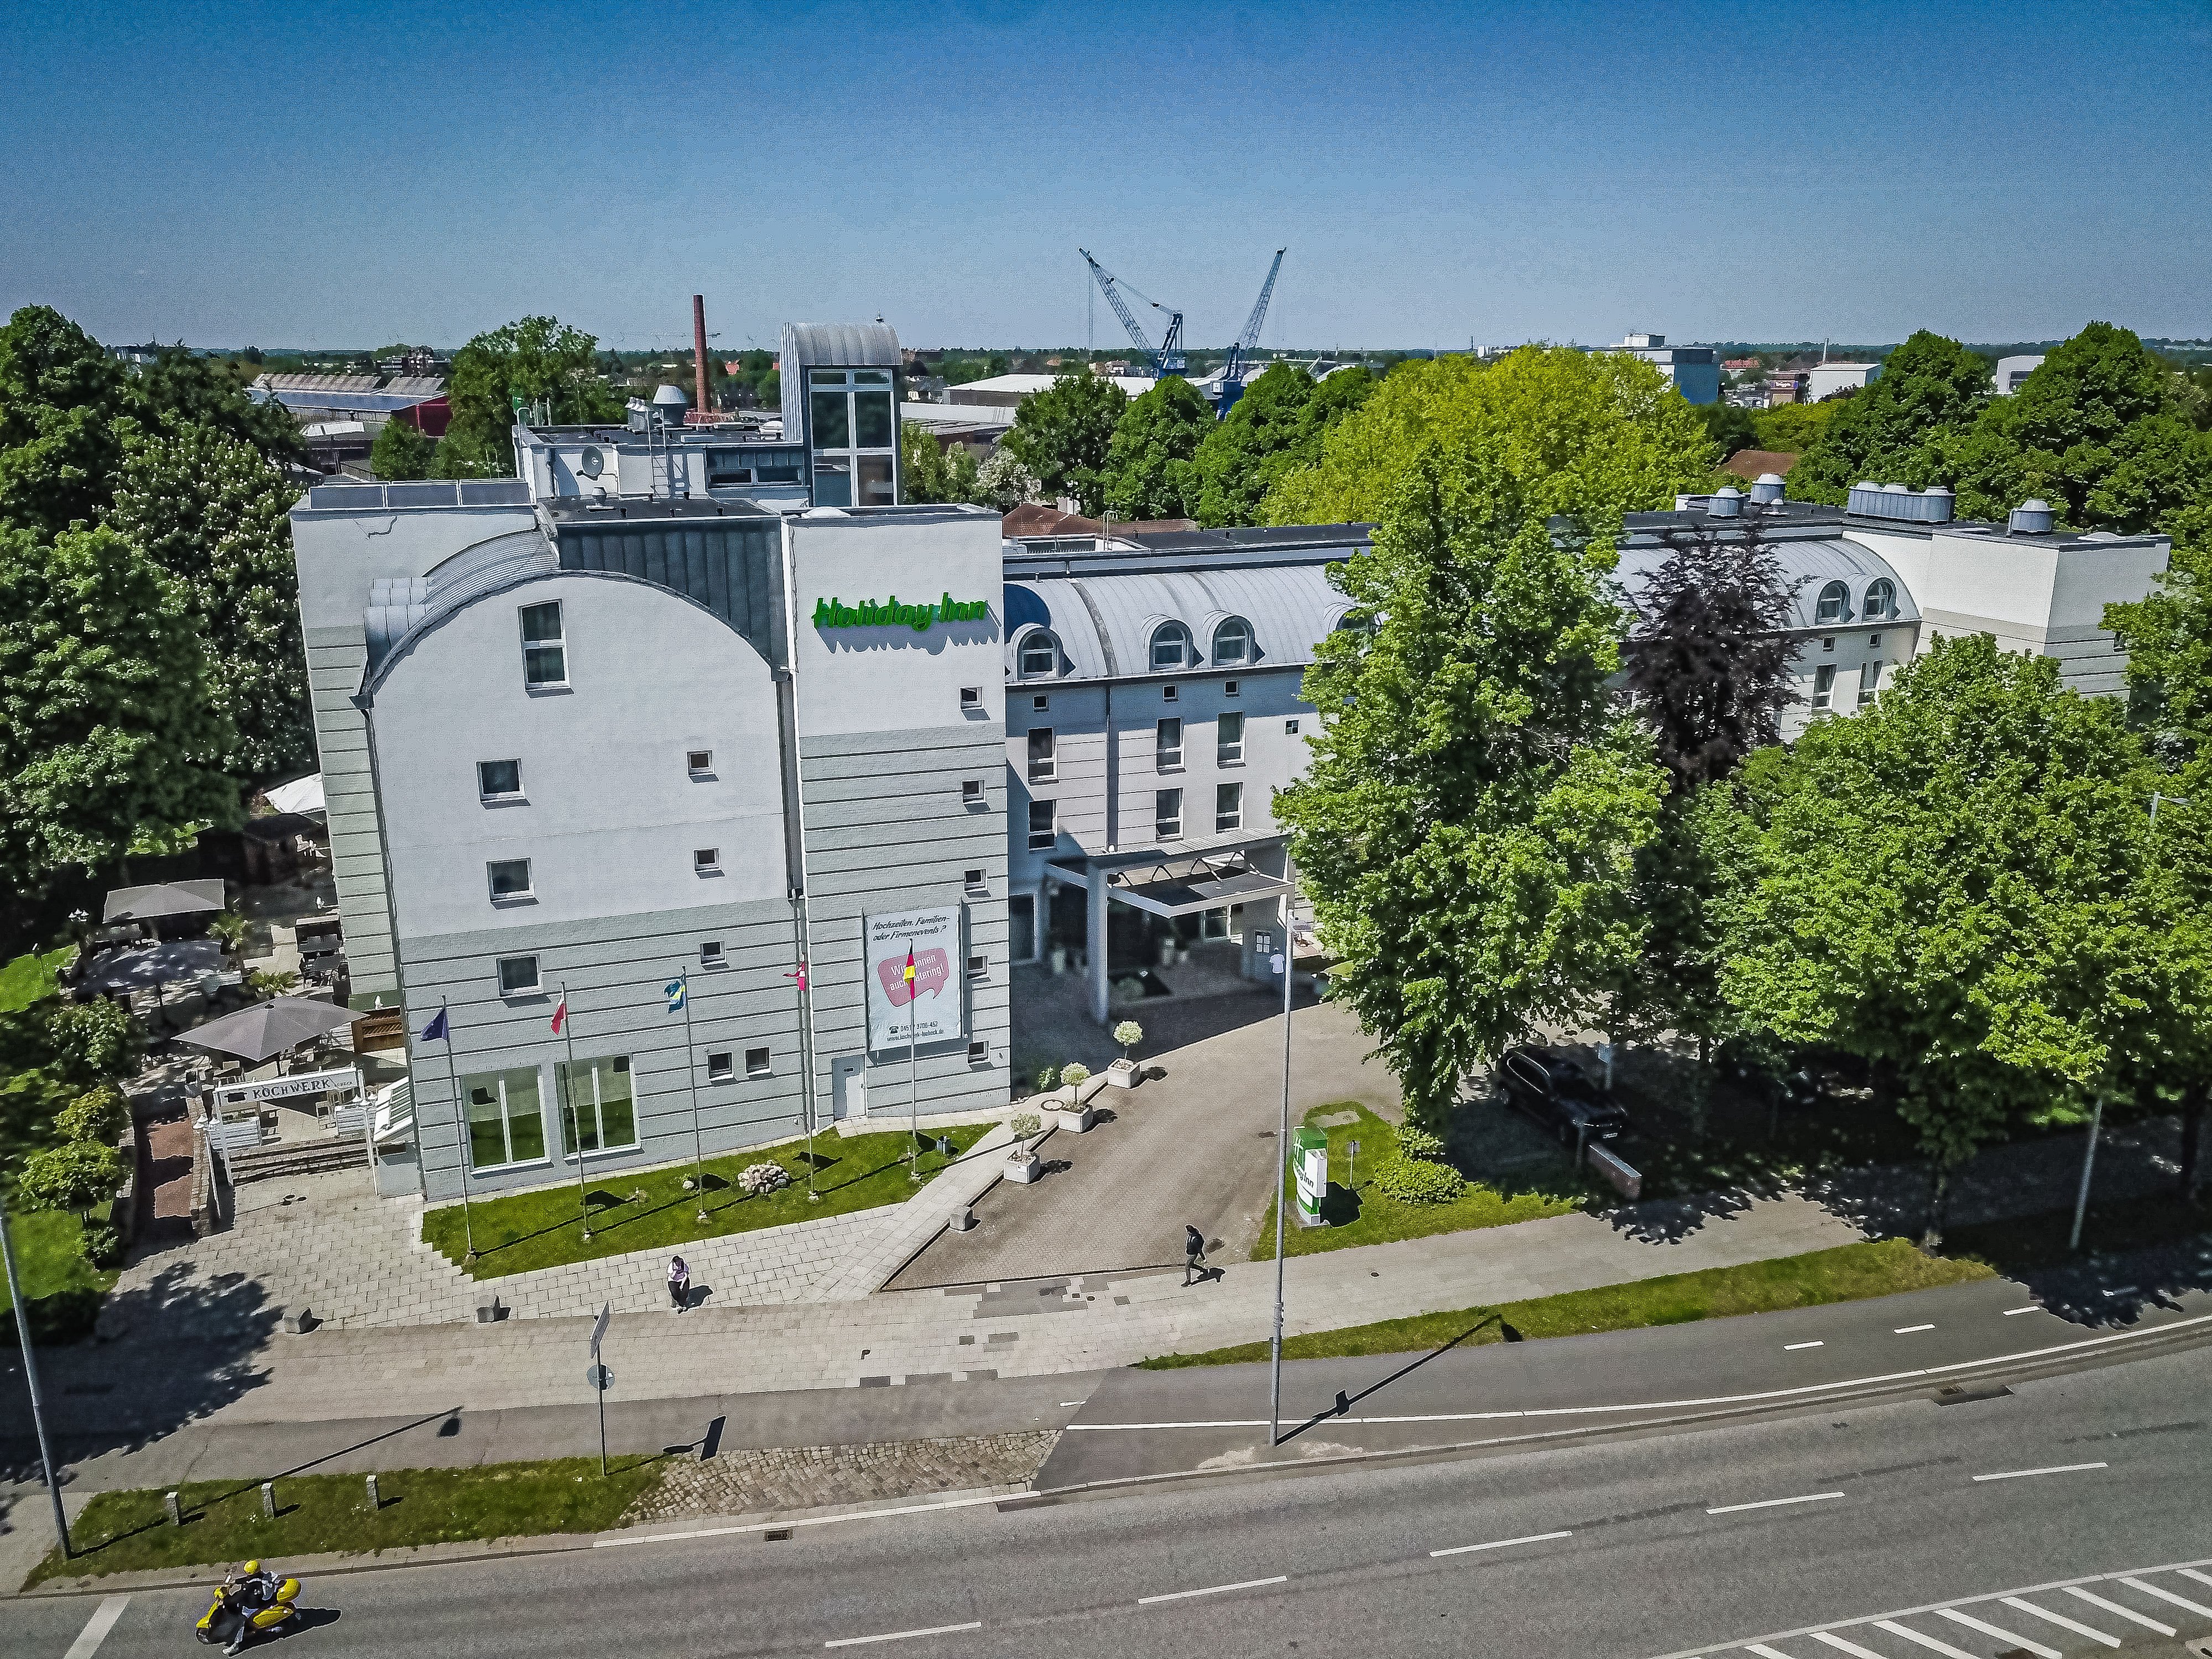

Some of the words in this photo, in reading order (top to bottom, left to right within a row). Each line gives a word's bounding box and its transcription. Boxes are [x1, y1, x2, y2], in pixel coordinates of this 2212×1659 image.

[811, 596, 933, 632] Holiday
[938, 592, 987, 622] Inn
[915, 914, 950, 926] Familien-
[873, 932, 890, 941] oder
[914, 962, 945, 982] atering!
[252, 1078, 331, 1099] KOCHWERK
[1304, 1172, 1314, 1188] Inn
